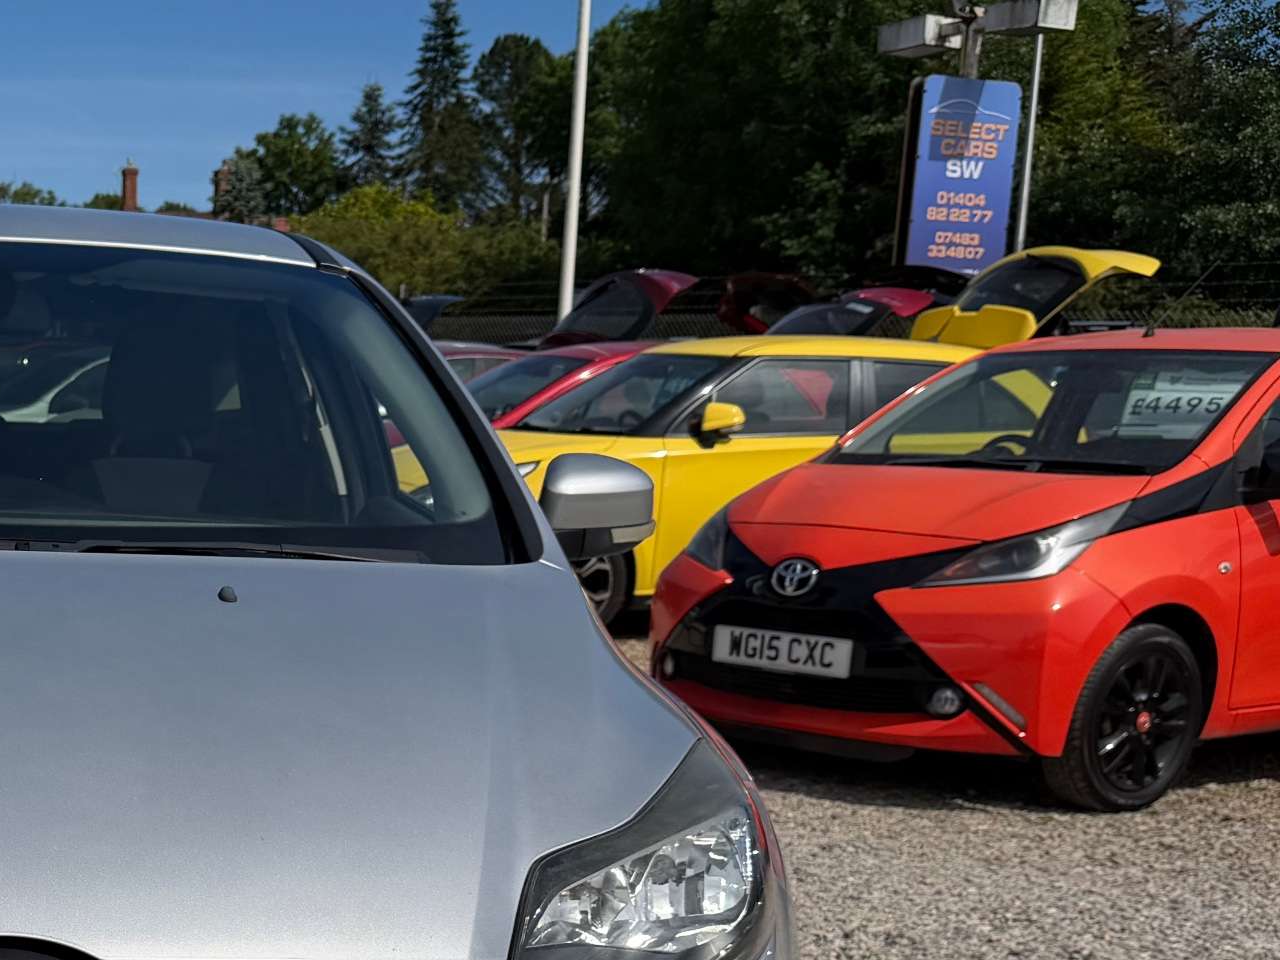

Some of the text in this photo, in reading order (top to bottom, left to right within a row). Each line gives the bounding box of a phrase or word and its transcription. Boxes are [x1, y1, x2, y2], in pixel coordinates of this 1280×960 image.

[931, 119, 1009, 141] SELECT
[941, 139, 998, 160] CARS
[946, 159, 984, 179] SW
[937, 191, 986, 207] 01404
[1128, 396, 1224, 415] £4495
[728, 630, 835, 668] WG15 CXC
